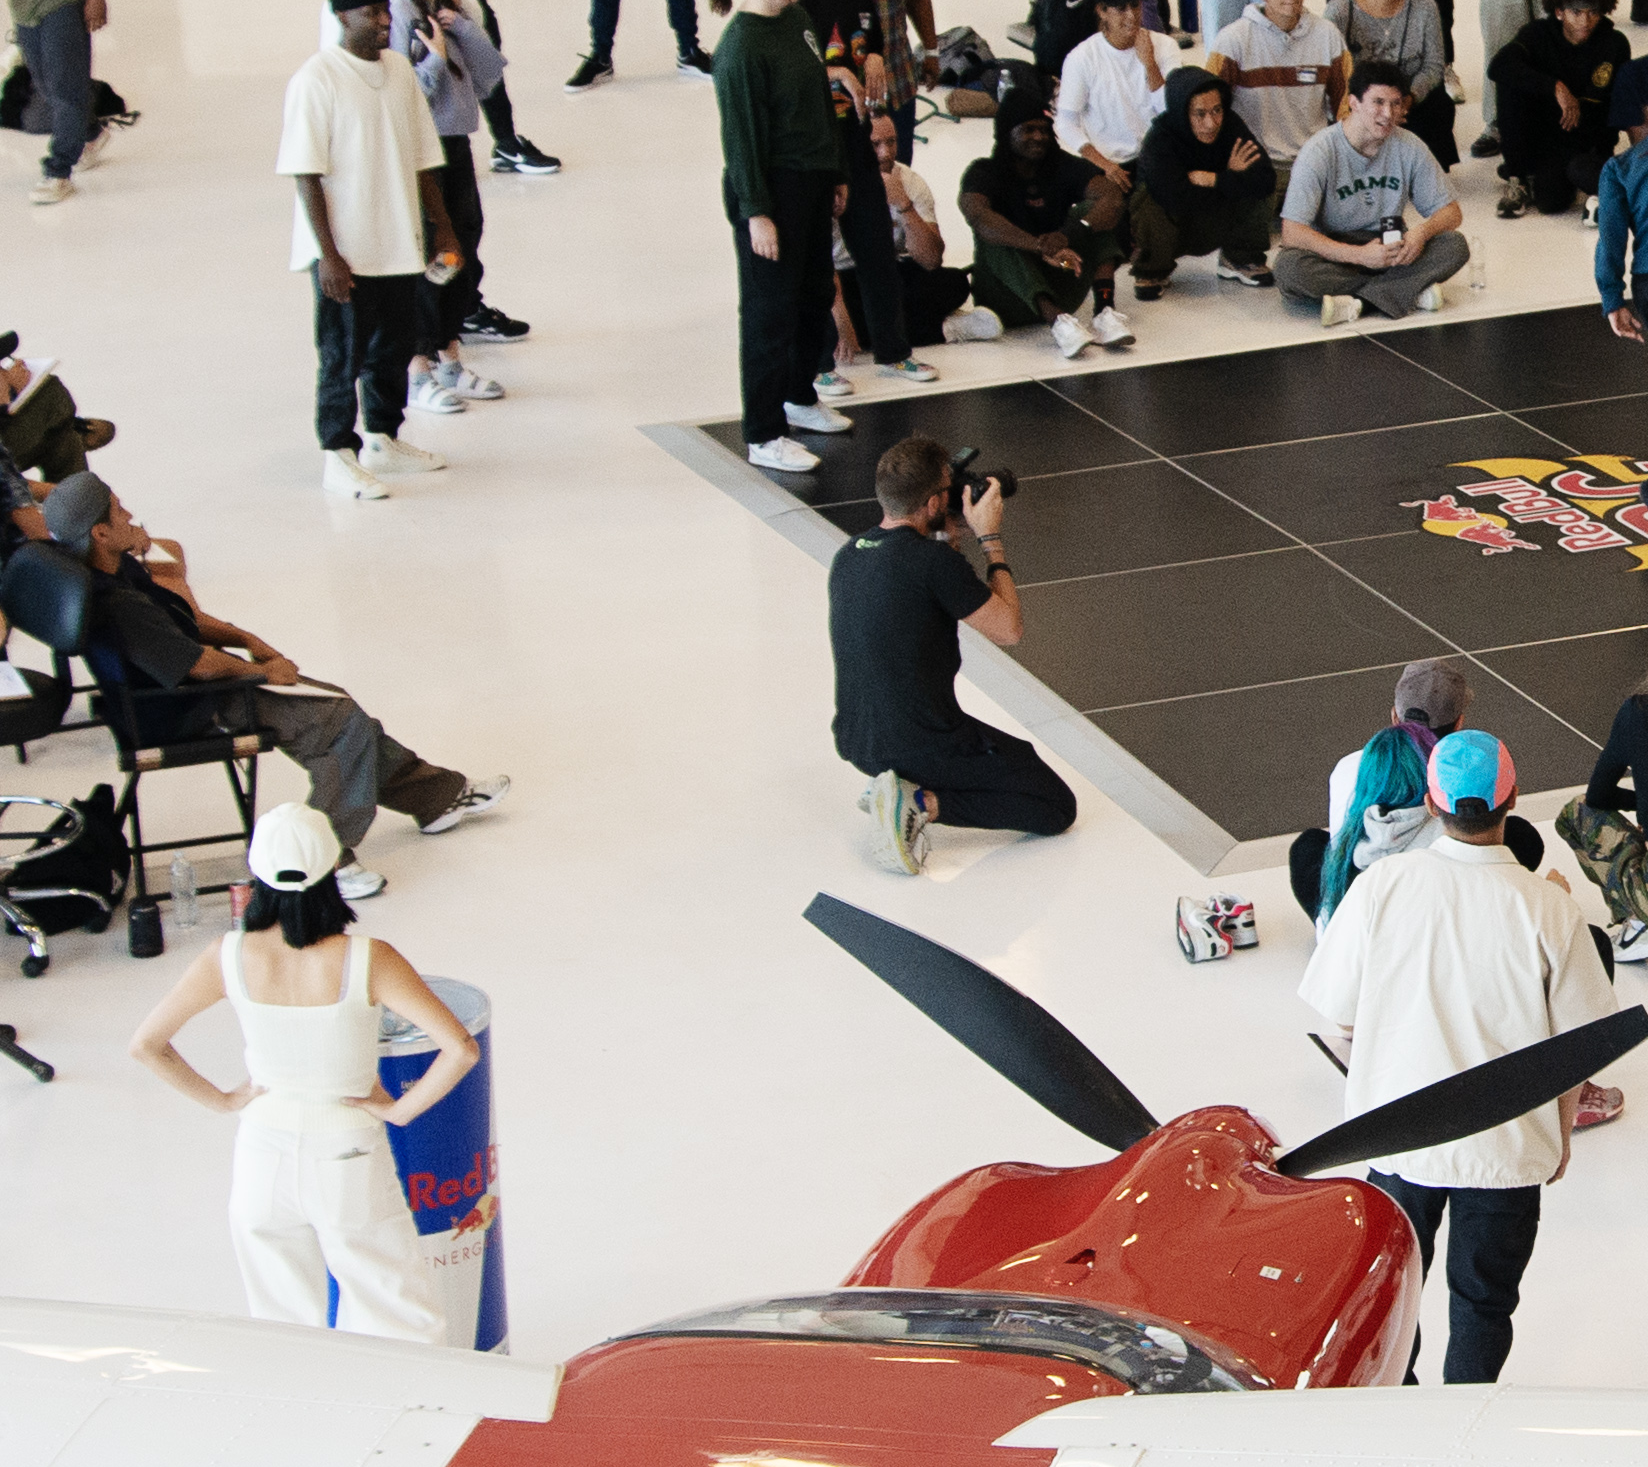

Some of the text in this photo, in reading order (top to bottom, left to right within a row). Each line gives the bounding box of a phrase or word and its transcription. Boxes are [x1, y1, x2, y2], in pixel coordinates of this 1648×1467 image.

[1336, 175, 1400, 201] RAMS
[1457, 475, 1634, 554] Red Bull
[407, 1151, 484, 1213] Red
